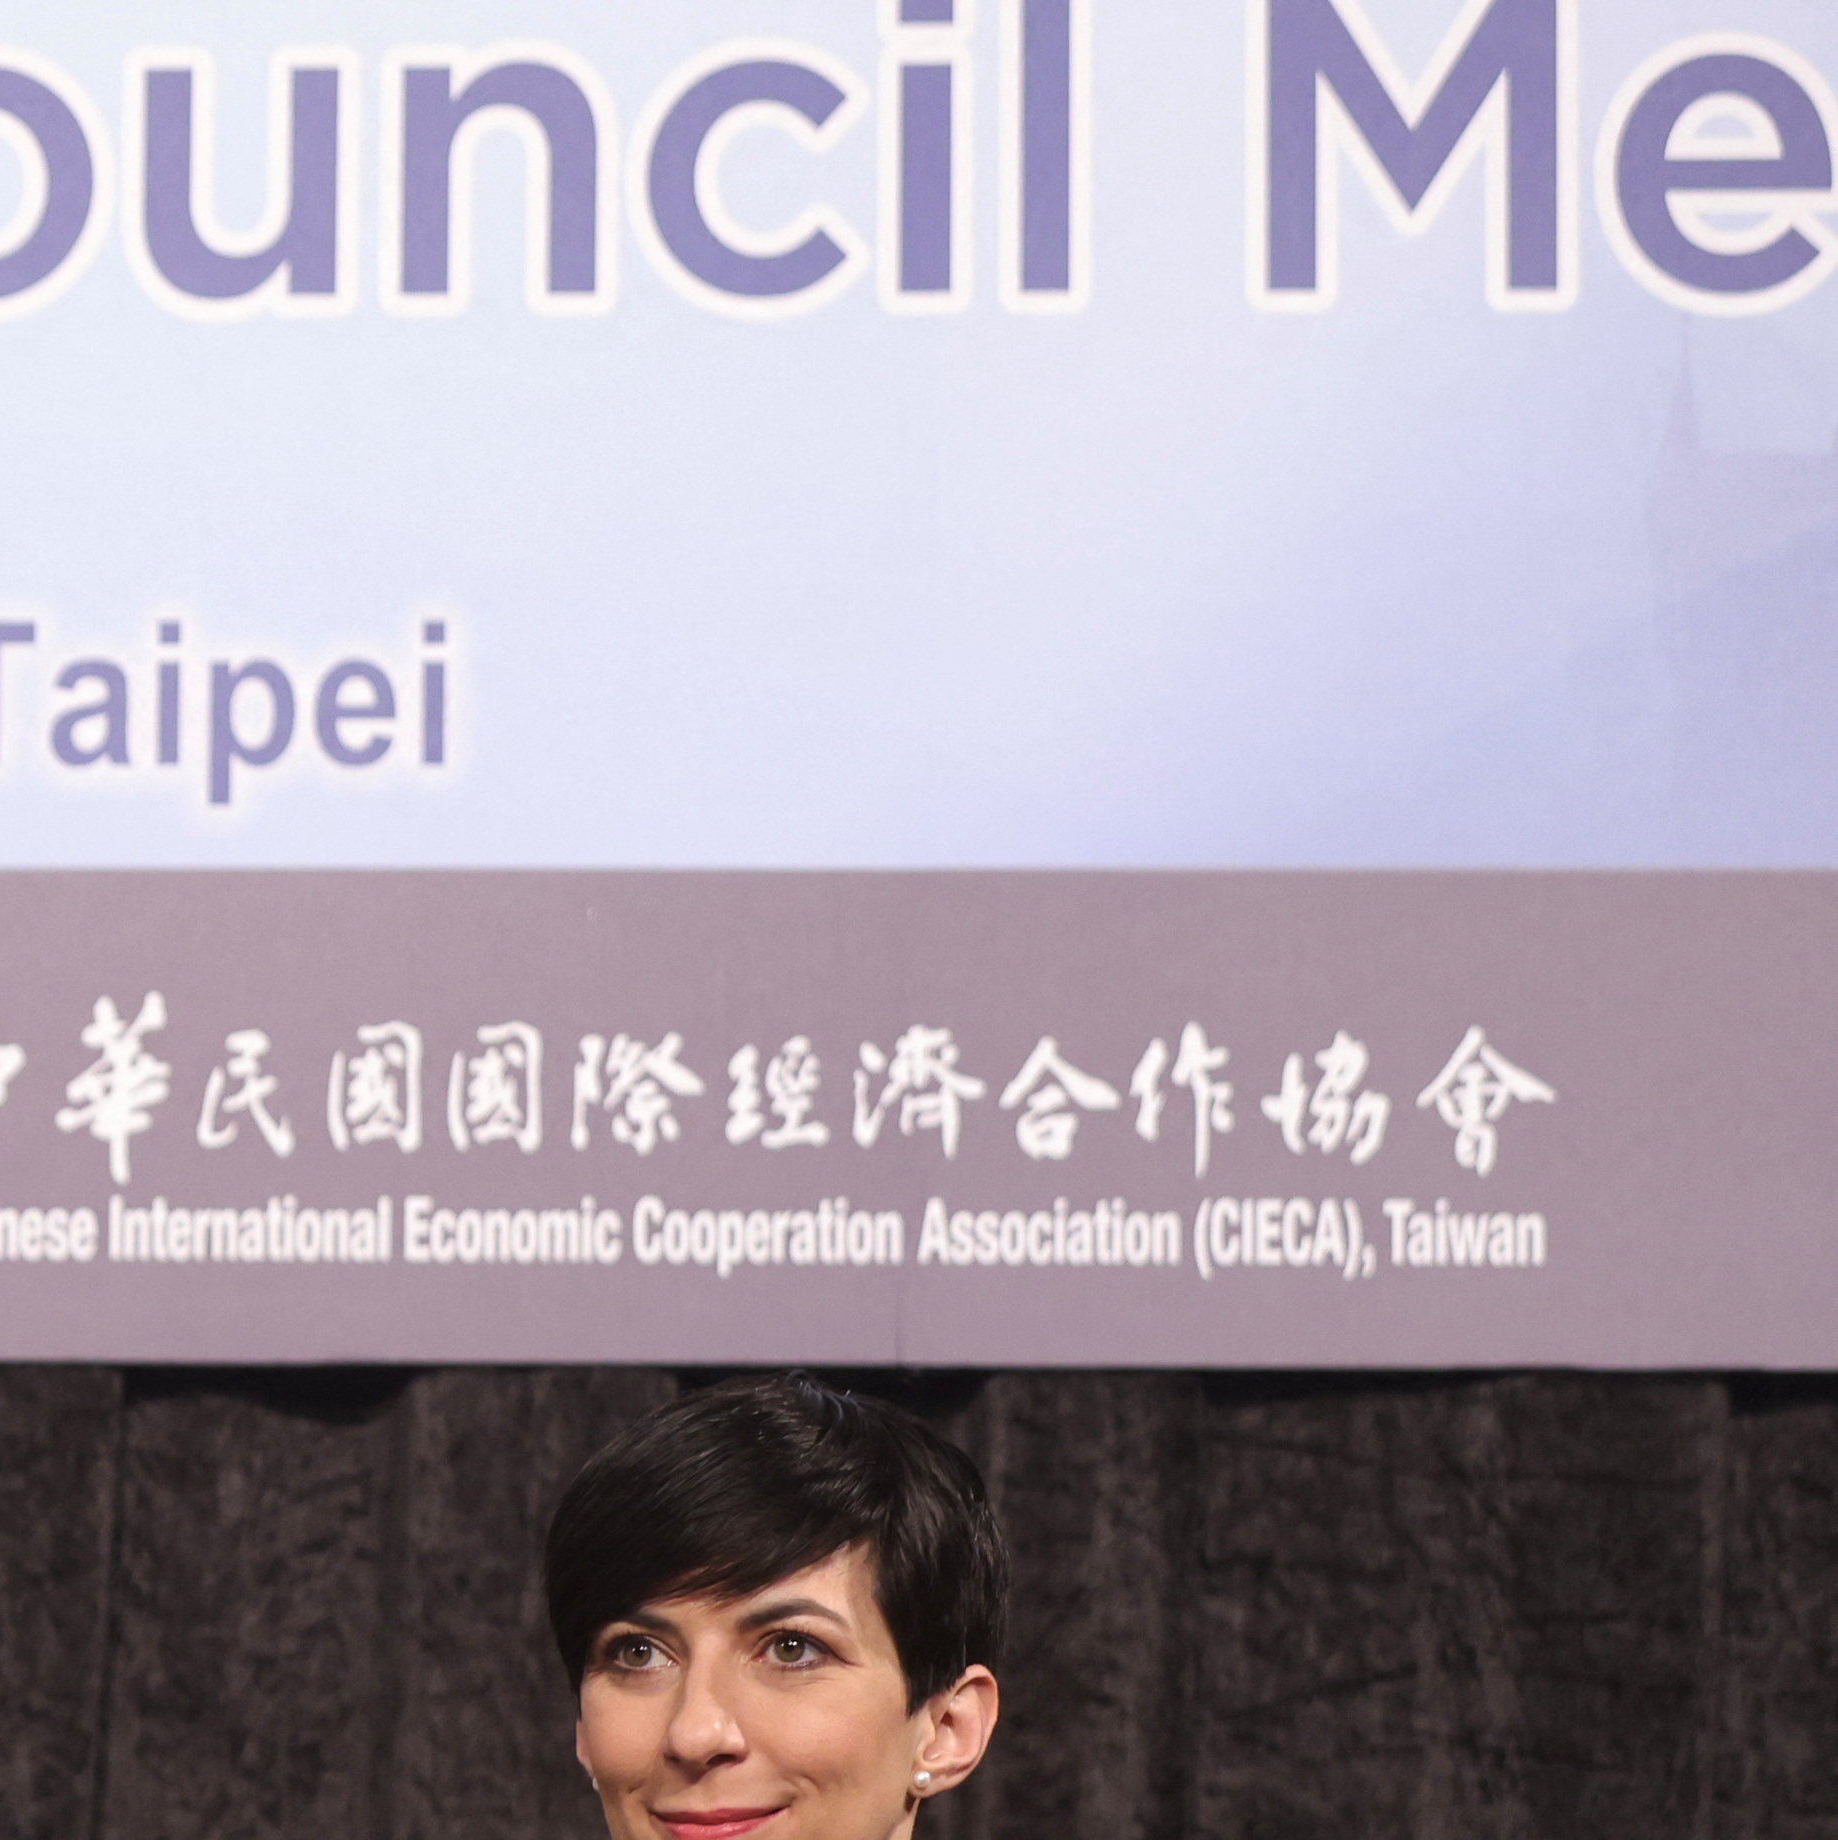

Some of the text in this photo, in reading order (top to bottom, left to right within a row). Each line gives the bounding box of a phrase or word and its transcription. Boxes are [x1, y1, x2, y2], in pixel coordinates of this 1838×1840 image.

[1265, 0, 1834, 297] Me
[109, 1195, 393, 1263] International
[404, 1196, 623, 1264] Economic
[633, 1197, 904, 1277] Cooperation
[918, 1198, 1182, 1266] Association
[1194, 1198, 1376, 1279] (CIECA),
[1383, 1199, 1546, 1267] Taiwan
